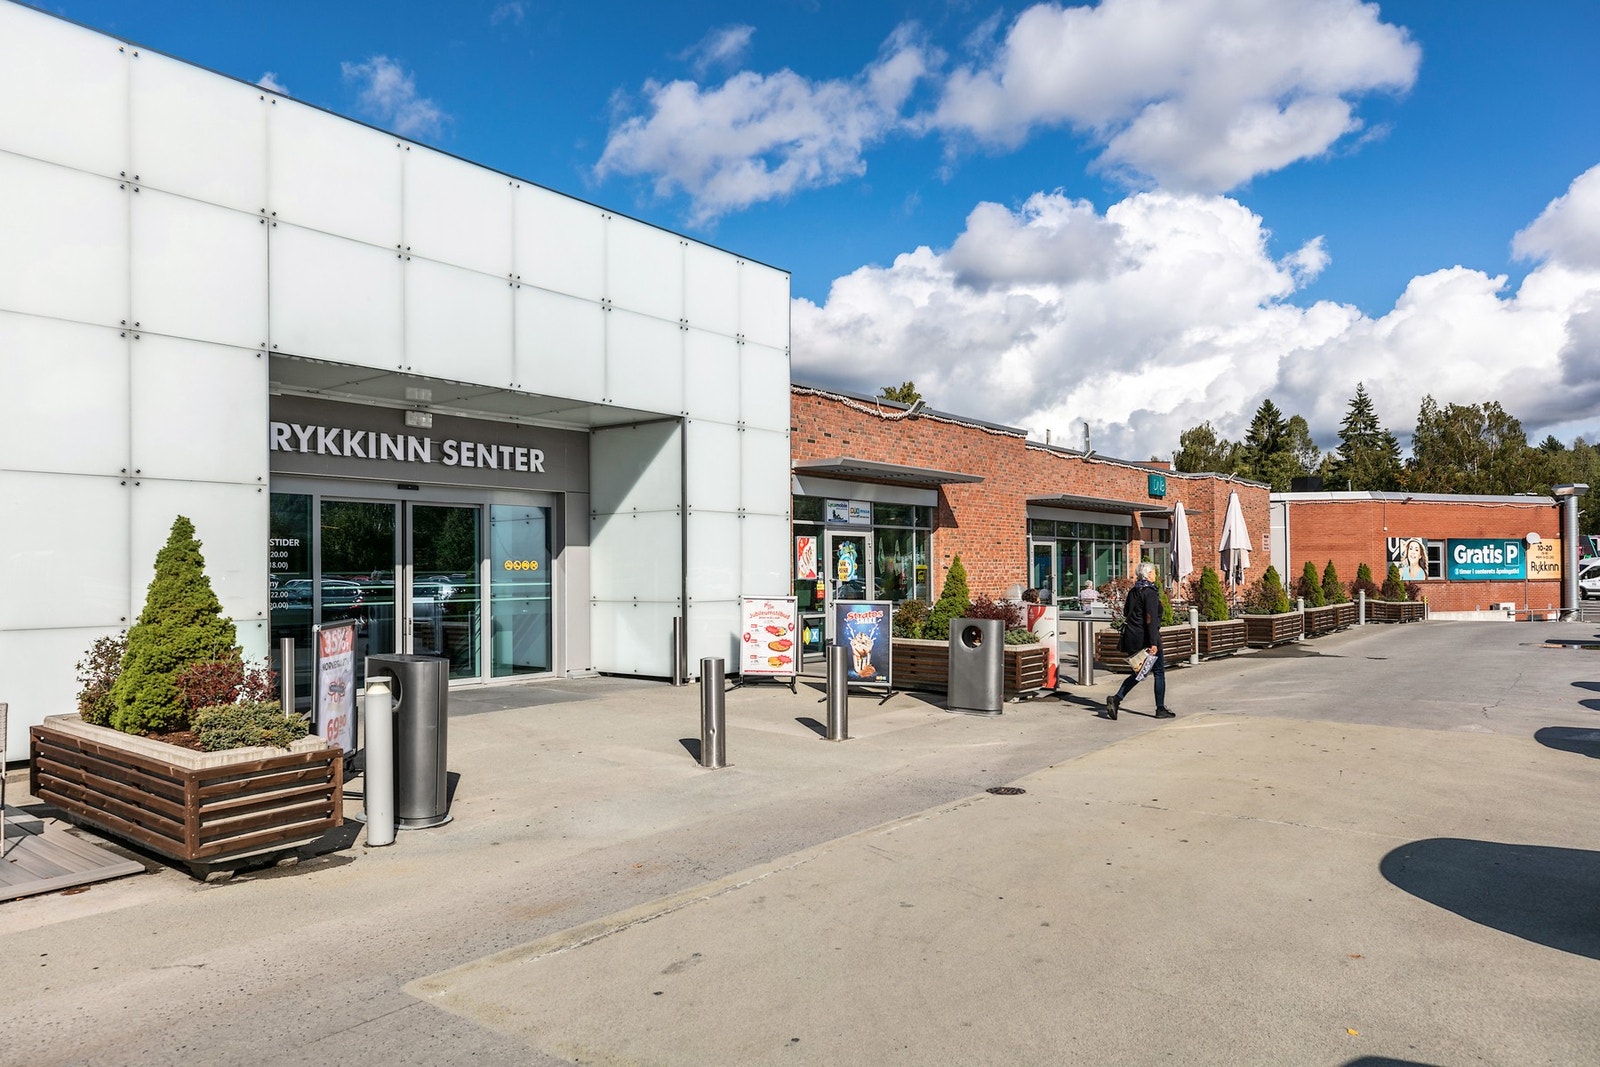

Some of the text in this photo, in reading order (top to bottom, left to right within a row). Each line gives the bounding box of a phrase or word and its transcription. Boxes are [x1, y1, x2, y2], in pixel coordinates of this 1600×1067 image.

[269, 421, 546, 473] RYKKINN SENTER
[269, 539, 300, 547] STIDER
[1454, 544, 1518, 564] Gratis P
[1530, 561, 1560, 574] Rykkinn
[847, 611, 884, 620] Stratos
[856, 617, 877, 625] SHAKE
